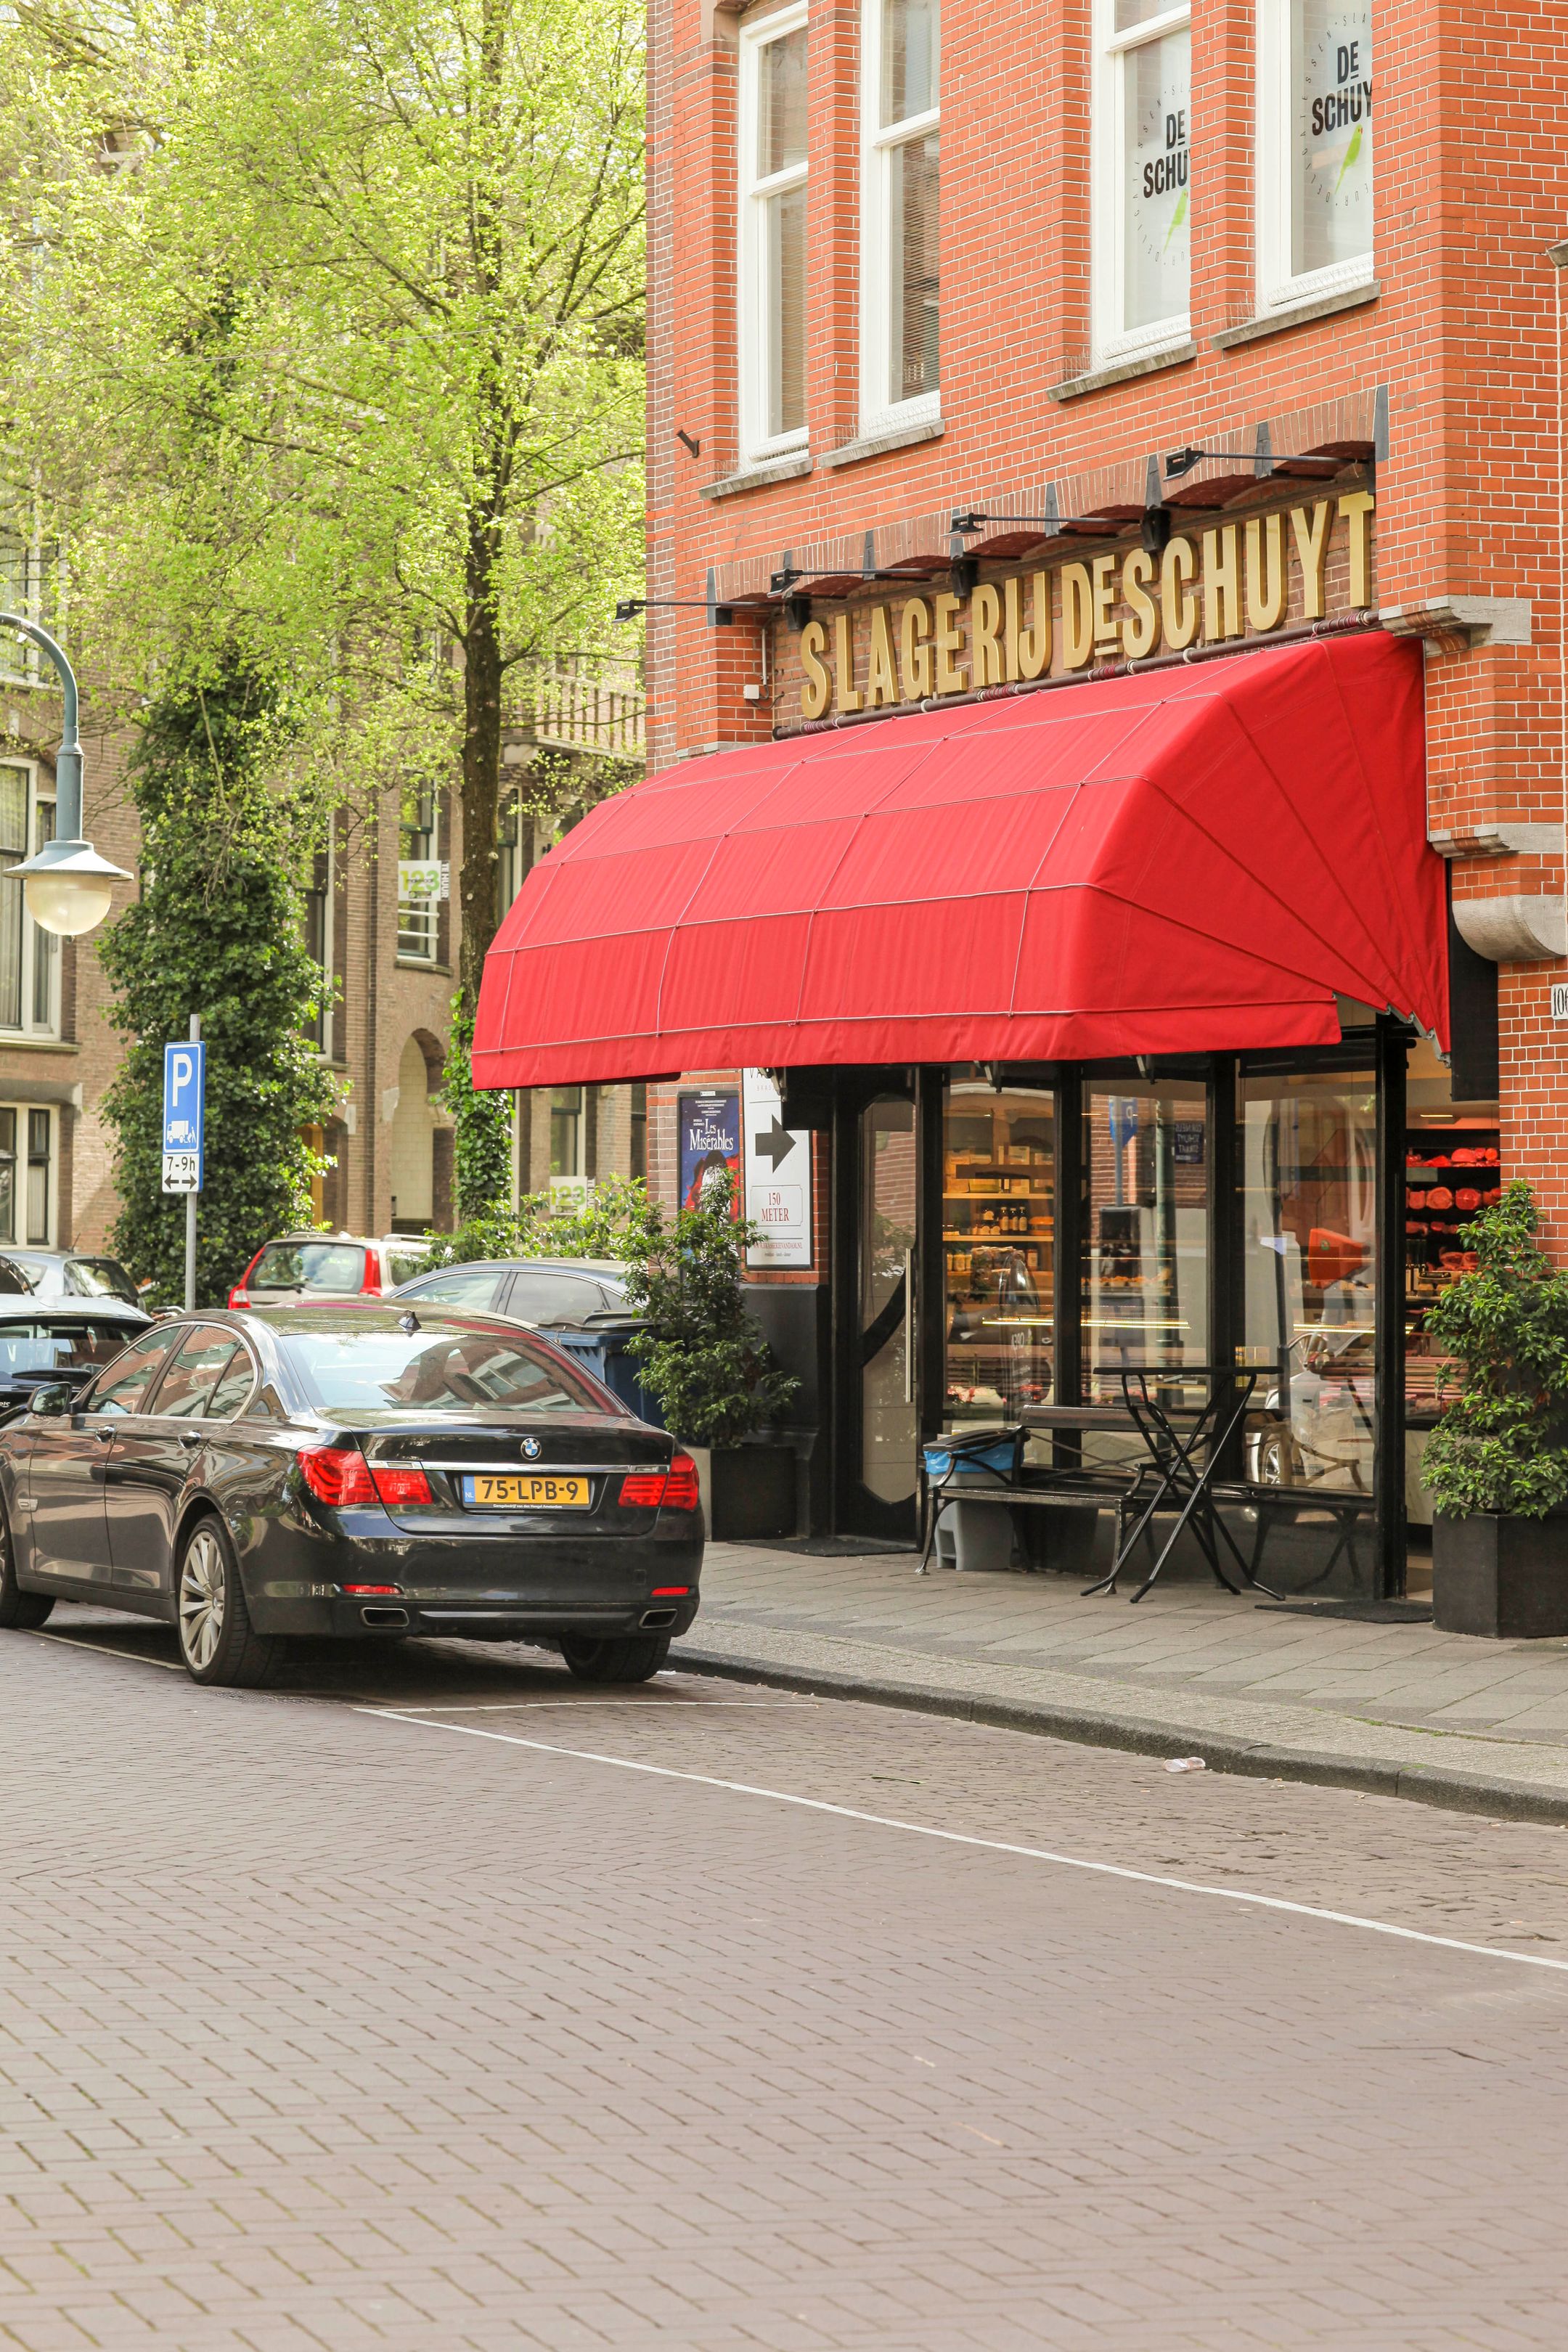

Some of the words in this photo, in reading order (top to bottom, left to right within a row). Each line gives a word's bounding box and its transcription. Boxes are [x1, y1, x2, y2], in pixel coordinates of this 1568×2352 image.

[1337, 40, 1359, 84] DE
[1166, 110, 1185, 150] DE
[1143, 149, 1191, 198] SCHU
[801, 571, 1051, 720] SLAGERIJ
[441, 863, 449, 872] TE
[400, 870, 440, 892] 123
[172, 1053, 192, 1107] P
[705, 1119, 716, 1135] Les
[690, 1128, 733, 1151] Misérables
[550, 1185, 586, 1205] 123
[768, 1192, 781, 1206] 150
[761, 1208, 790, 1222] METER
[481, 1479, 579, 1500] 75-LPB-9
